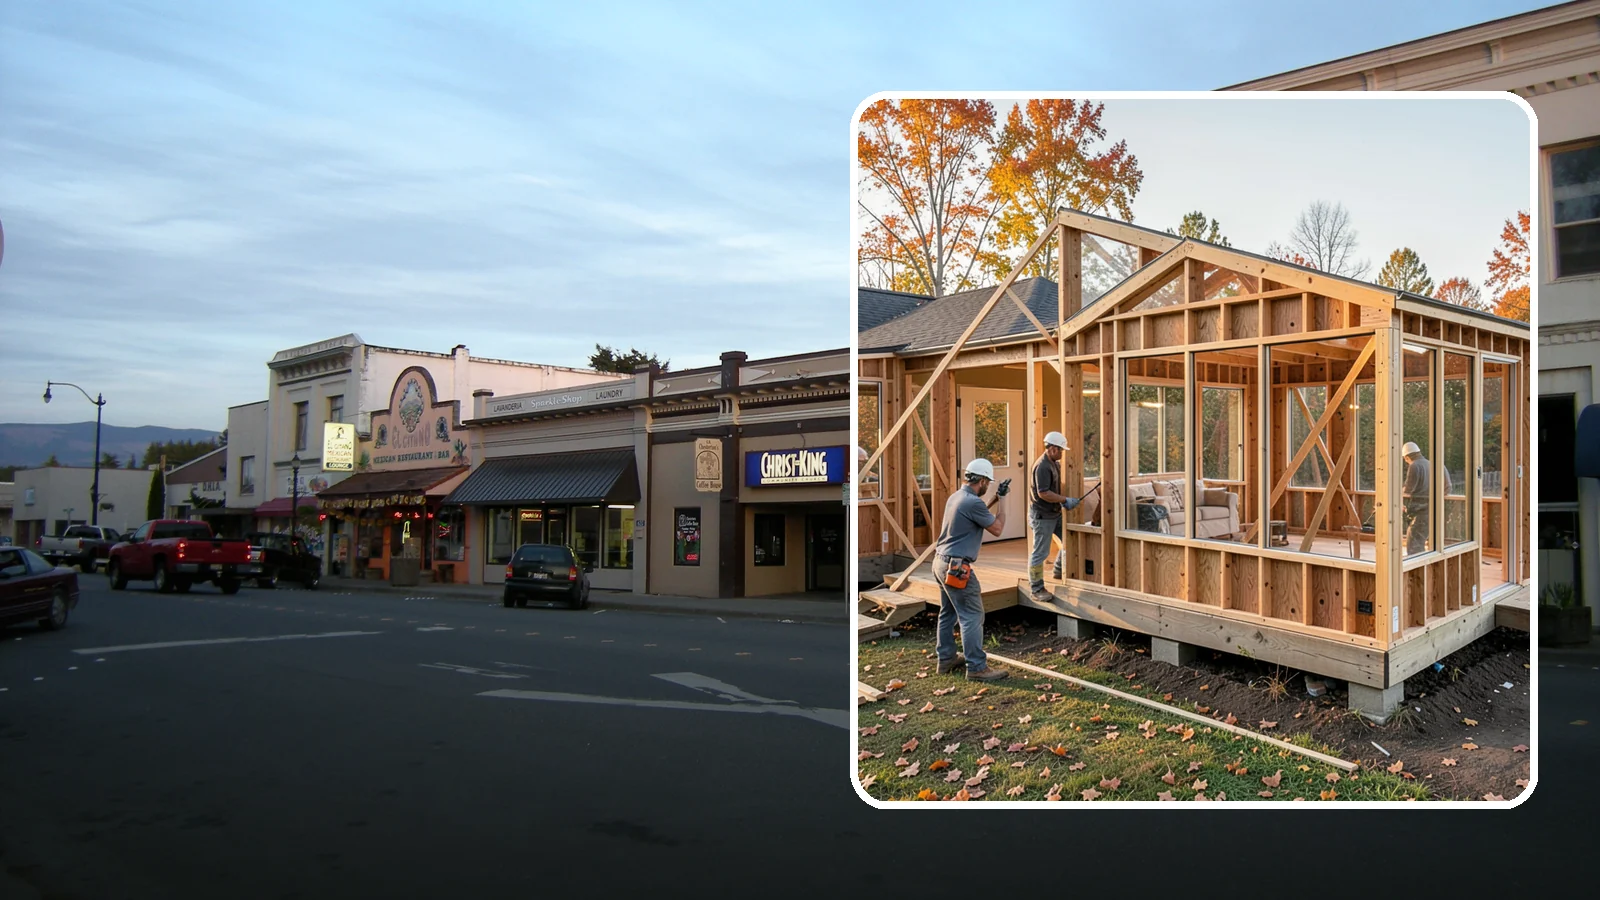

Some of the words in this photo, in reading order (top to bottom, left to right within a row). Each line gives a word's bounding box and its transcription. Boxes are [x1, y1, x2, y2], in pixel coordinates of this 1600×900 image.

[494, 402, 522, 412] LAVANDERIA
[531, 399, 560, 409] Sparkle
[561, 395, 582, 405] Shop
[595, 389, 623, 400] LAUNDRY
[373, 455, 396, 464] MEXICAN
[397, 451, 434, 462] RESTAURANT
[438, 450, 450, 459] BAR
[761, 452, 797, 477] CHRIST
[799, 450, 827, 476] KING
